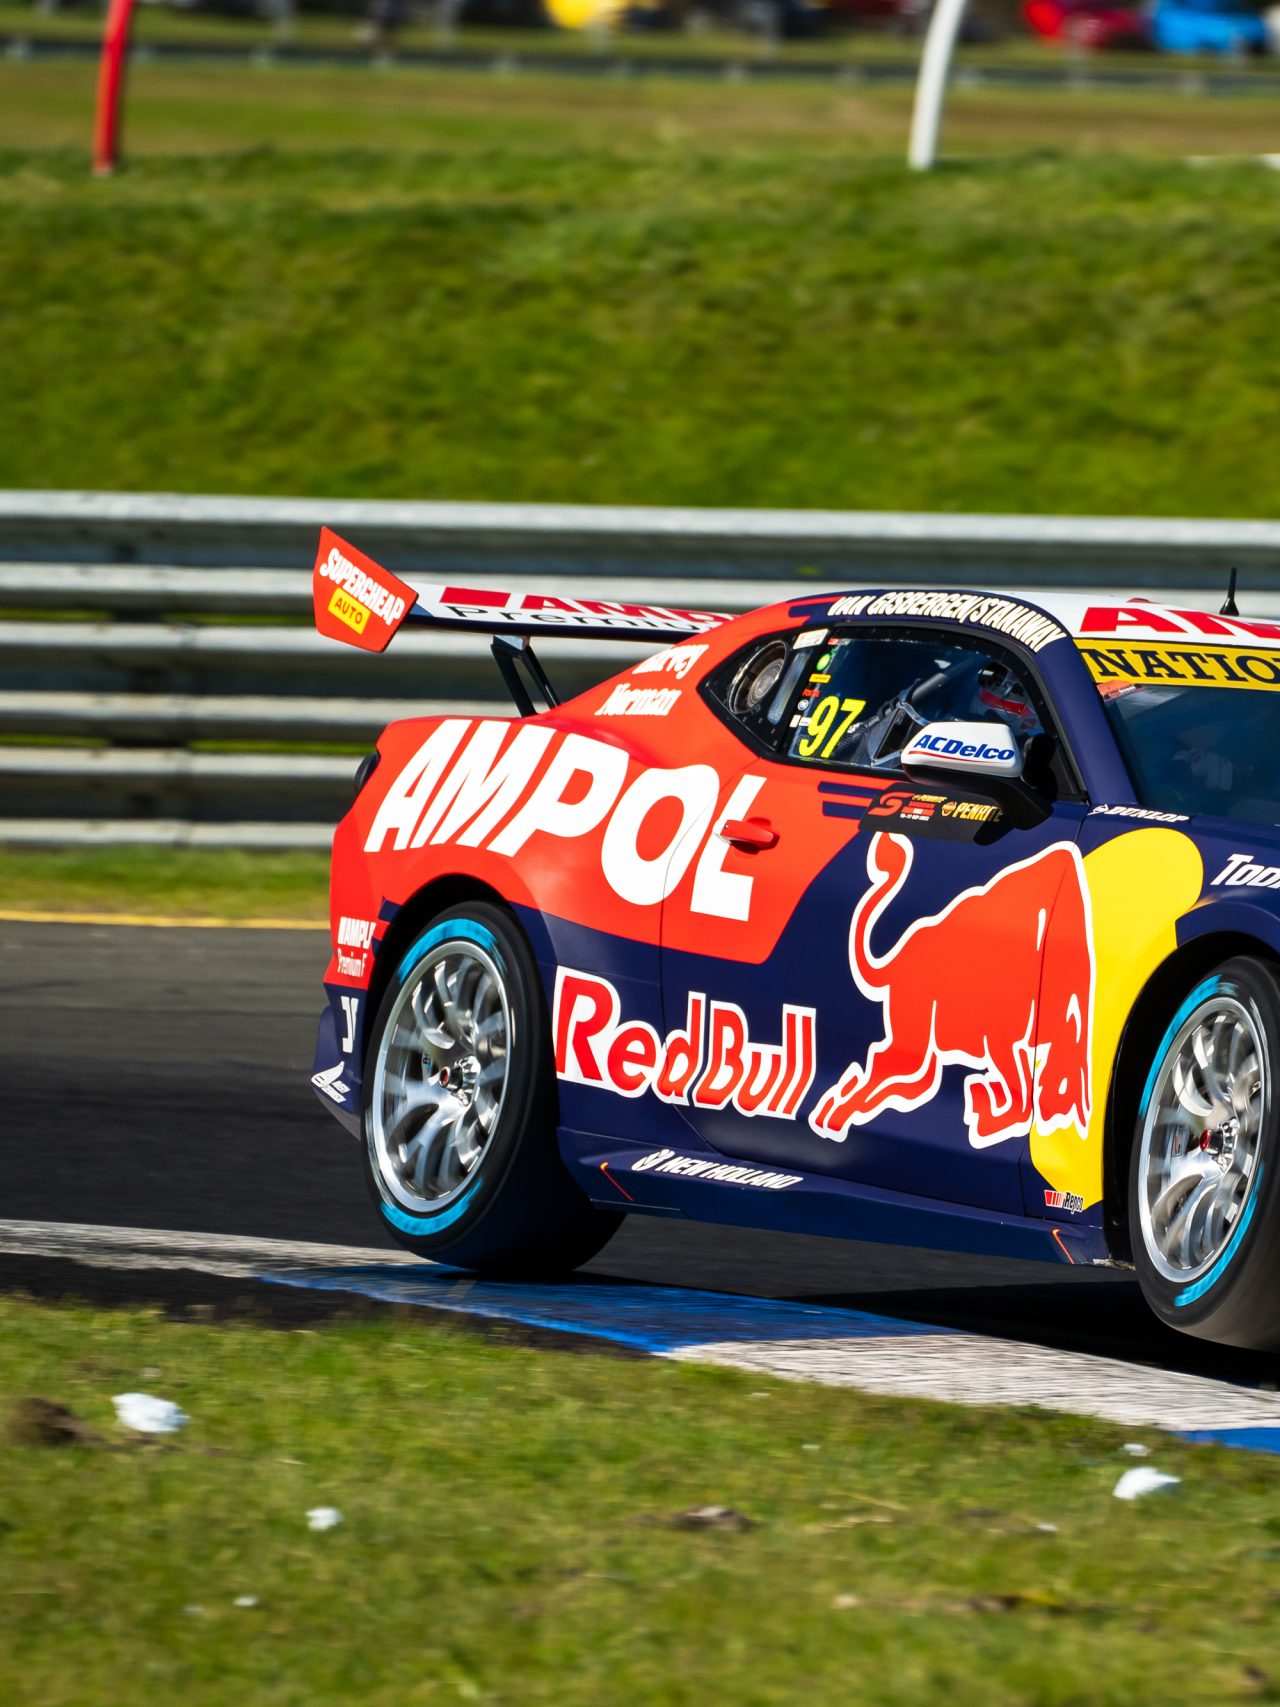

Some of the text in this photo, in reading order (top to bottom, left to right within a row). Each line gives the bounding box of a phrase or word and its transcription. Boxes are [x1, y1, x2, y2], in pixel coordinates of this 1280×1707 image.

[319, 547, 405, 626] SUPERCHEAP
[334, 597, 363, 625] AUTO
[827, 595, 876, 616] VAN
[799, 695, 866, 758] 97
[914, 734, 1015, 760] ACDelco
[364, 719, 768, 921] AMPOL
[952, 802, 1004, 822] PENRITE
[1105, 806, 1190, 823] DUNLOP
[552, 965, 816, 1120] Red Bull
[655, 1156, 804, 1189] NEW HOLLAND
